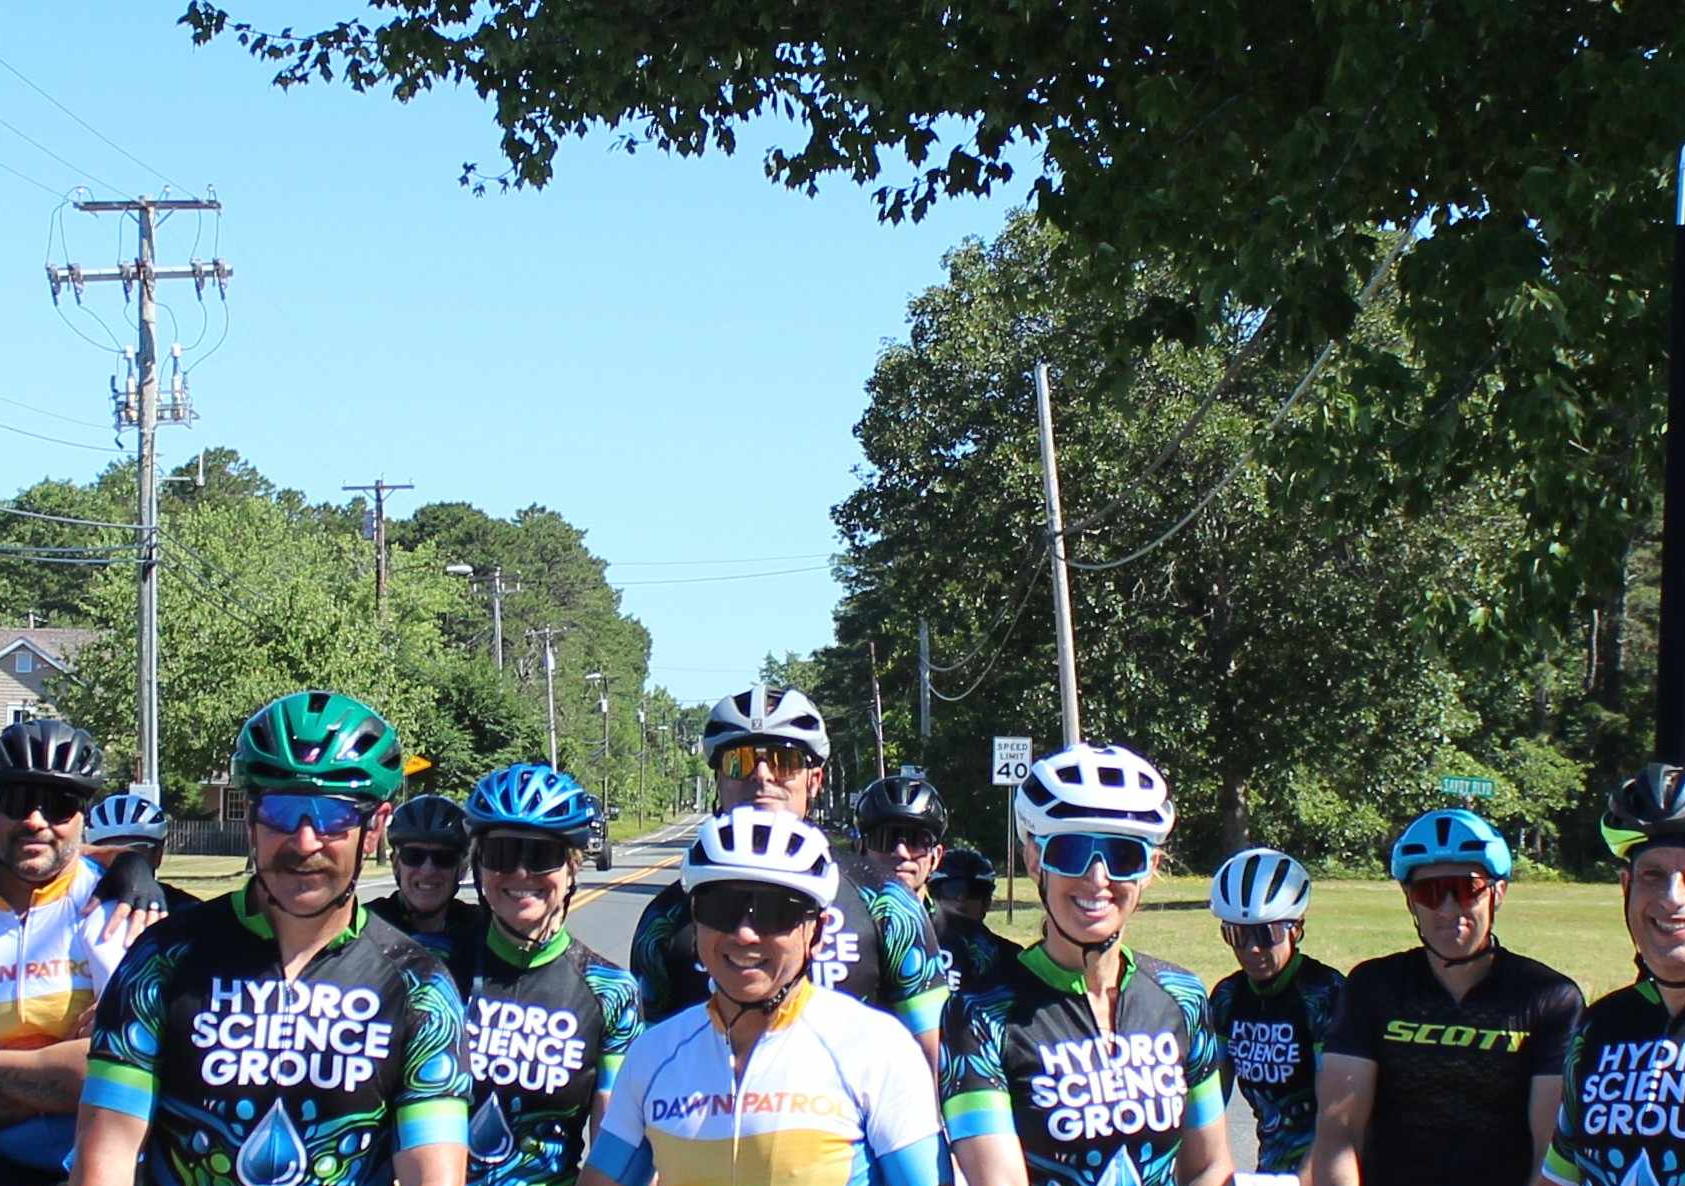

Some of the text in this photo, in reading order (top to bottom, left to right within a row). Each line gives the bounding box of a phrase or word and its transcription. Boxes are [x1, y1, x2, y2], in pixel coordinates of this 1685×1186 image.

[997, 762, 1028, 779] 40
[210, 977, 380, 1022] HYDRO
[477, 998, 578, 1040] YDRO
[190, 1011, 393, 1059] SCIENCE
[1228, 1039, 1301, 1063] SCIENCE
[1232, 1020, 1294, 1043] HYDRO
[1383, 1020, 1531, 1052] SCOTT
[201, 1050, 373, 1092] GROUP
[469, 1052, 570, 1095] ROUP
[1039, 1031, 1180, 1076] HYDRO
[1234, 1058, 1294, 1083] GROUP
[651, 1092, 843, 1121] DAWN PATROL
[1031, 1064, 1187, 1109] SCIENCE
[1047, 1095, 1184, 1142] GROUP
